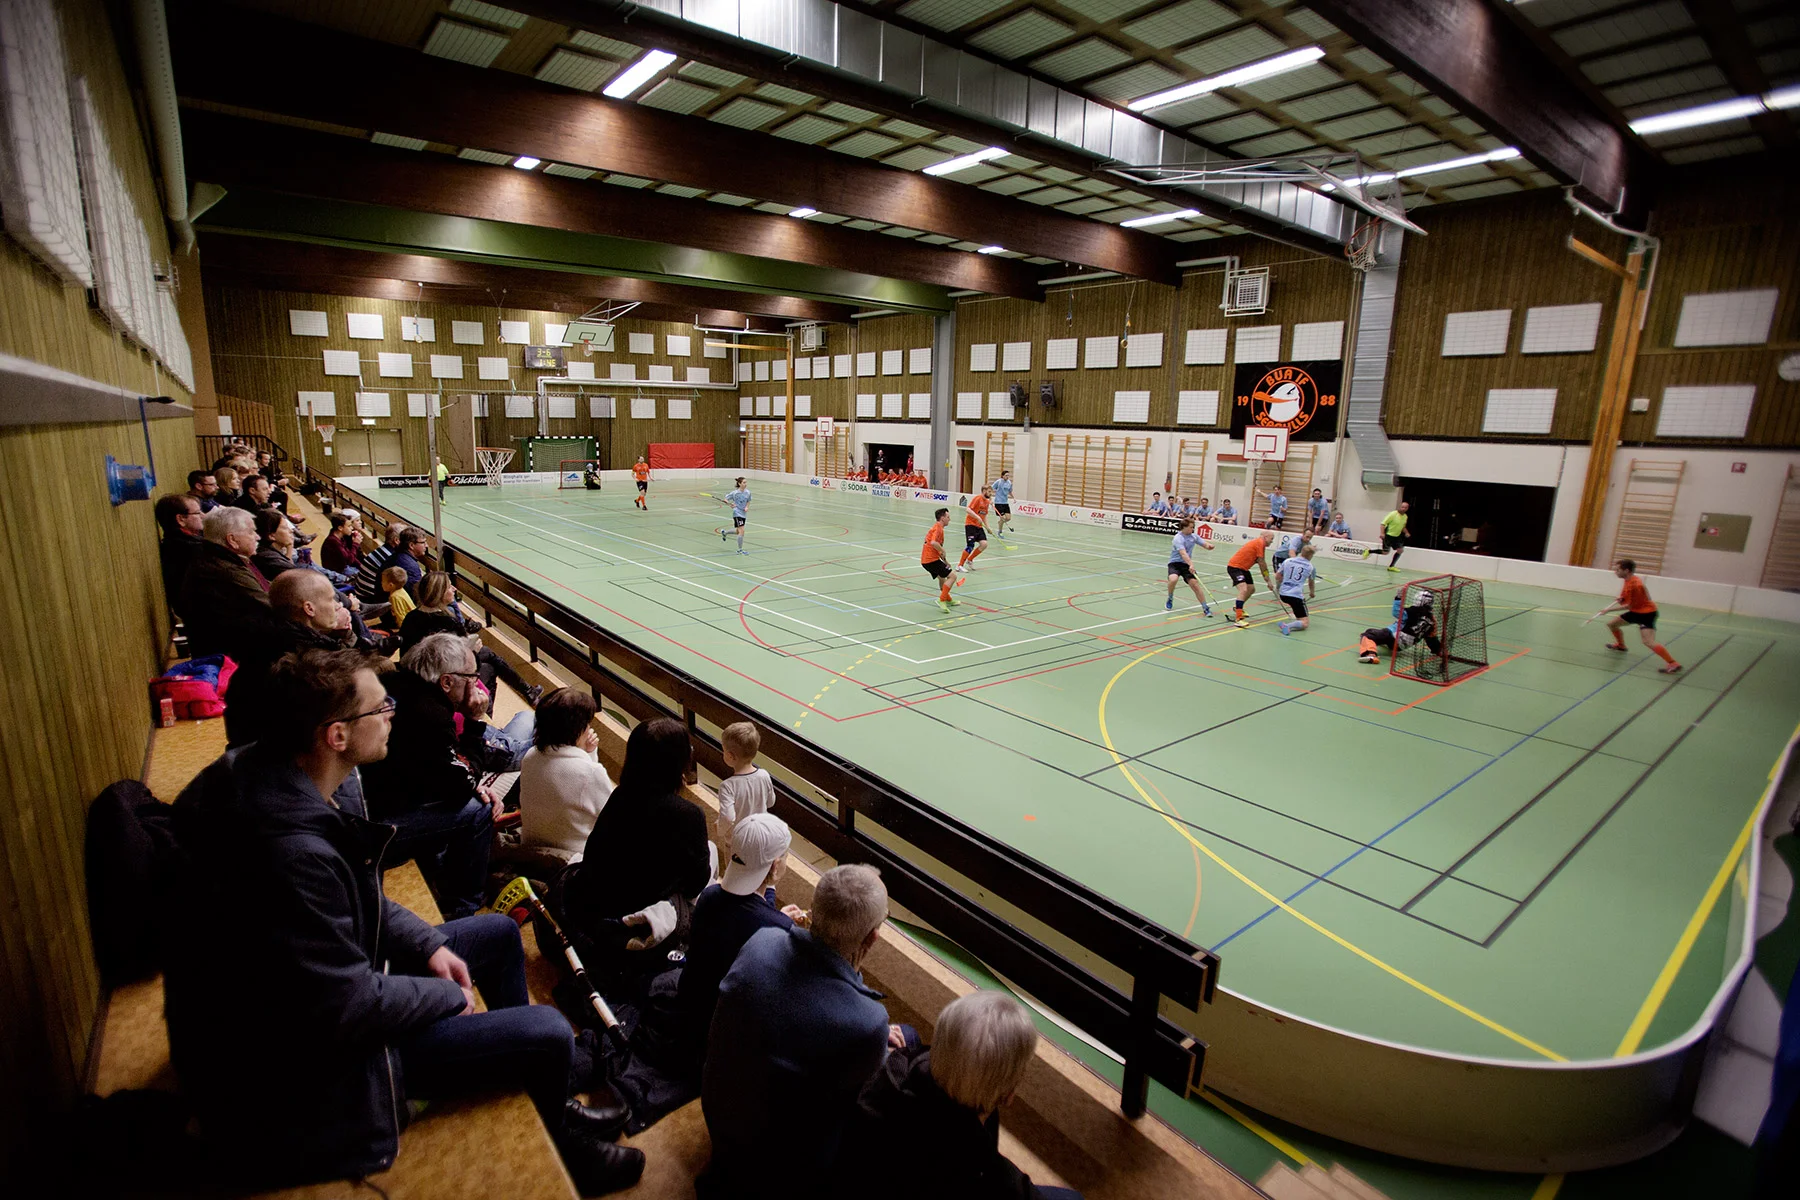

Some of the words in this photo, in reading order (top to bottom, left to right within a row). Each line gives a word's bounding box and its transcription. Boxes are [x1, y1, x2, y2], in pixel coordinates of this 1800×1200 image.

[1265, 369, 1293, 387] BUA
[1295, 373, 1310, 386] IF
[1237, 396, 1249, 406] 19
[1320, 395, 1336, 406] 88
[847, 483, 868, 492] SÖDRA
[920, 491, 948, 501] INTERSPORT
[1018, 505, 1044, 514] ACTIVE
[1200, 528, 1212, 539] JH
[1213, 532, 1234, 543] Bygg
[1333, 546, 1364, 555] ZACHRISSO
[1289, 566, 1304, 581] 13
